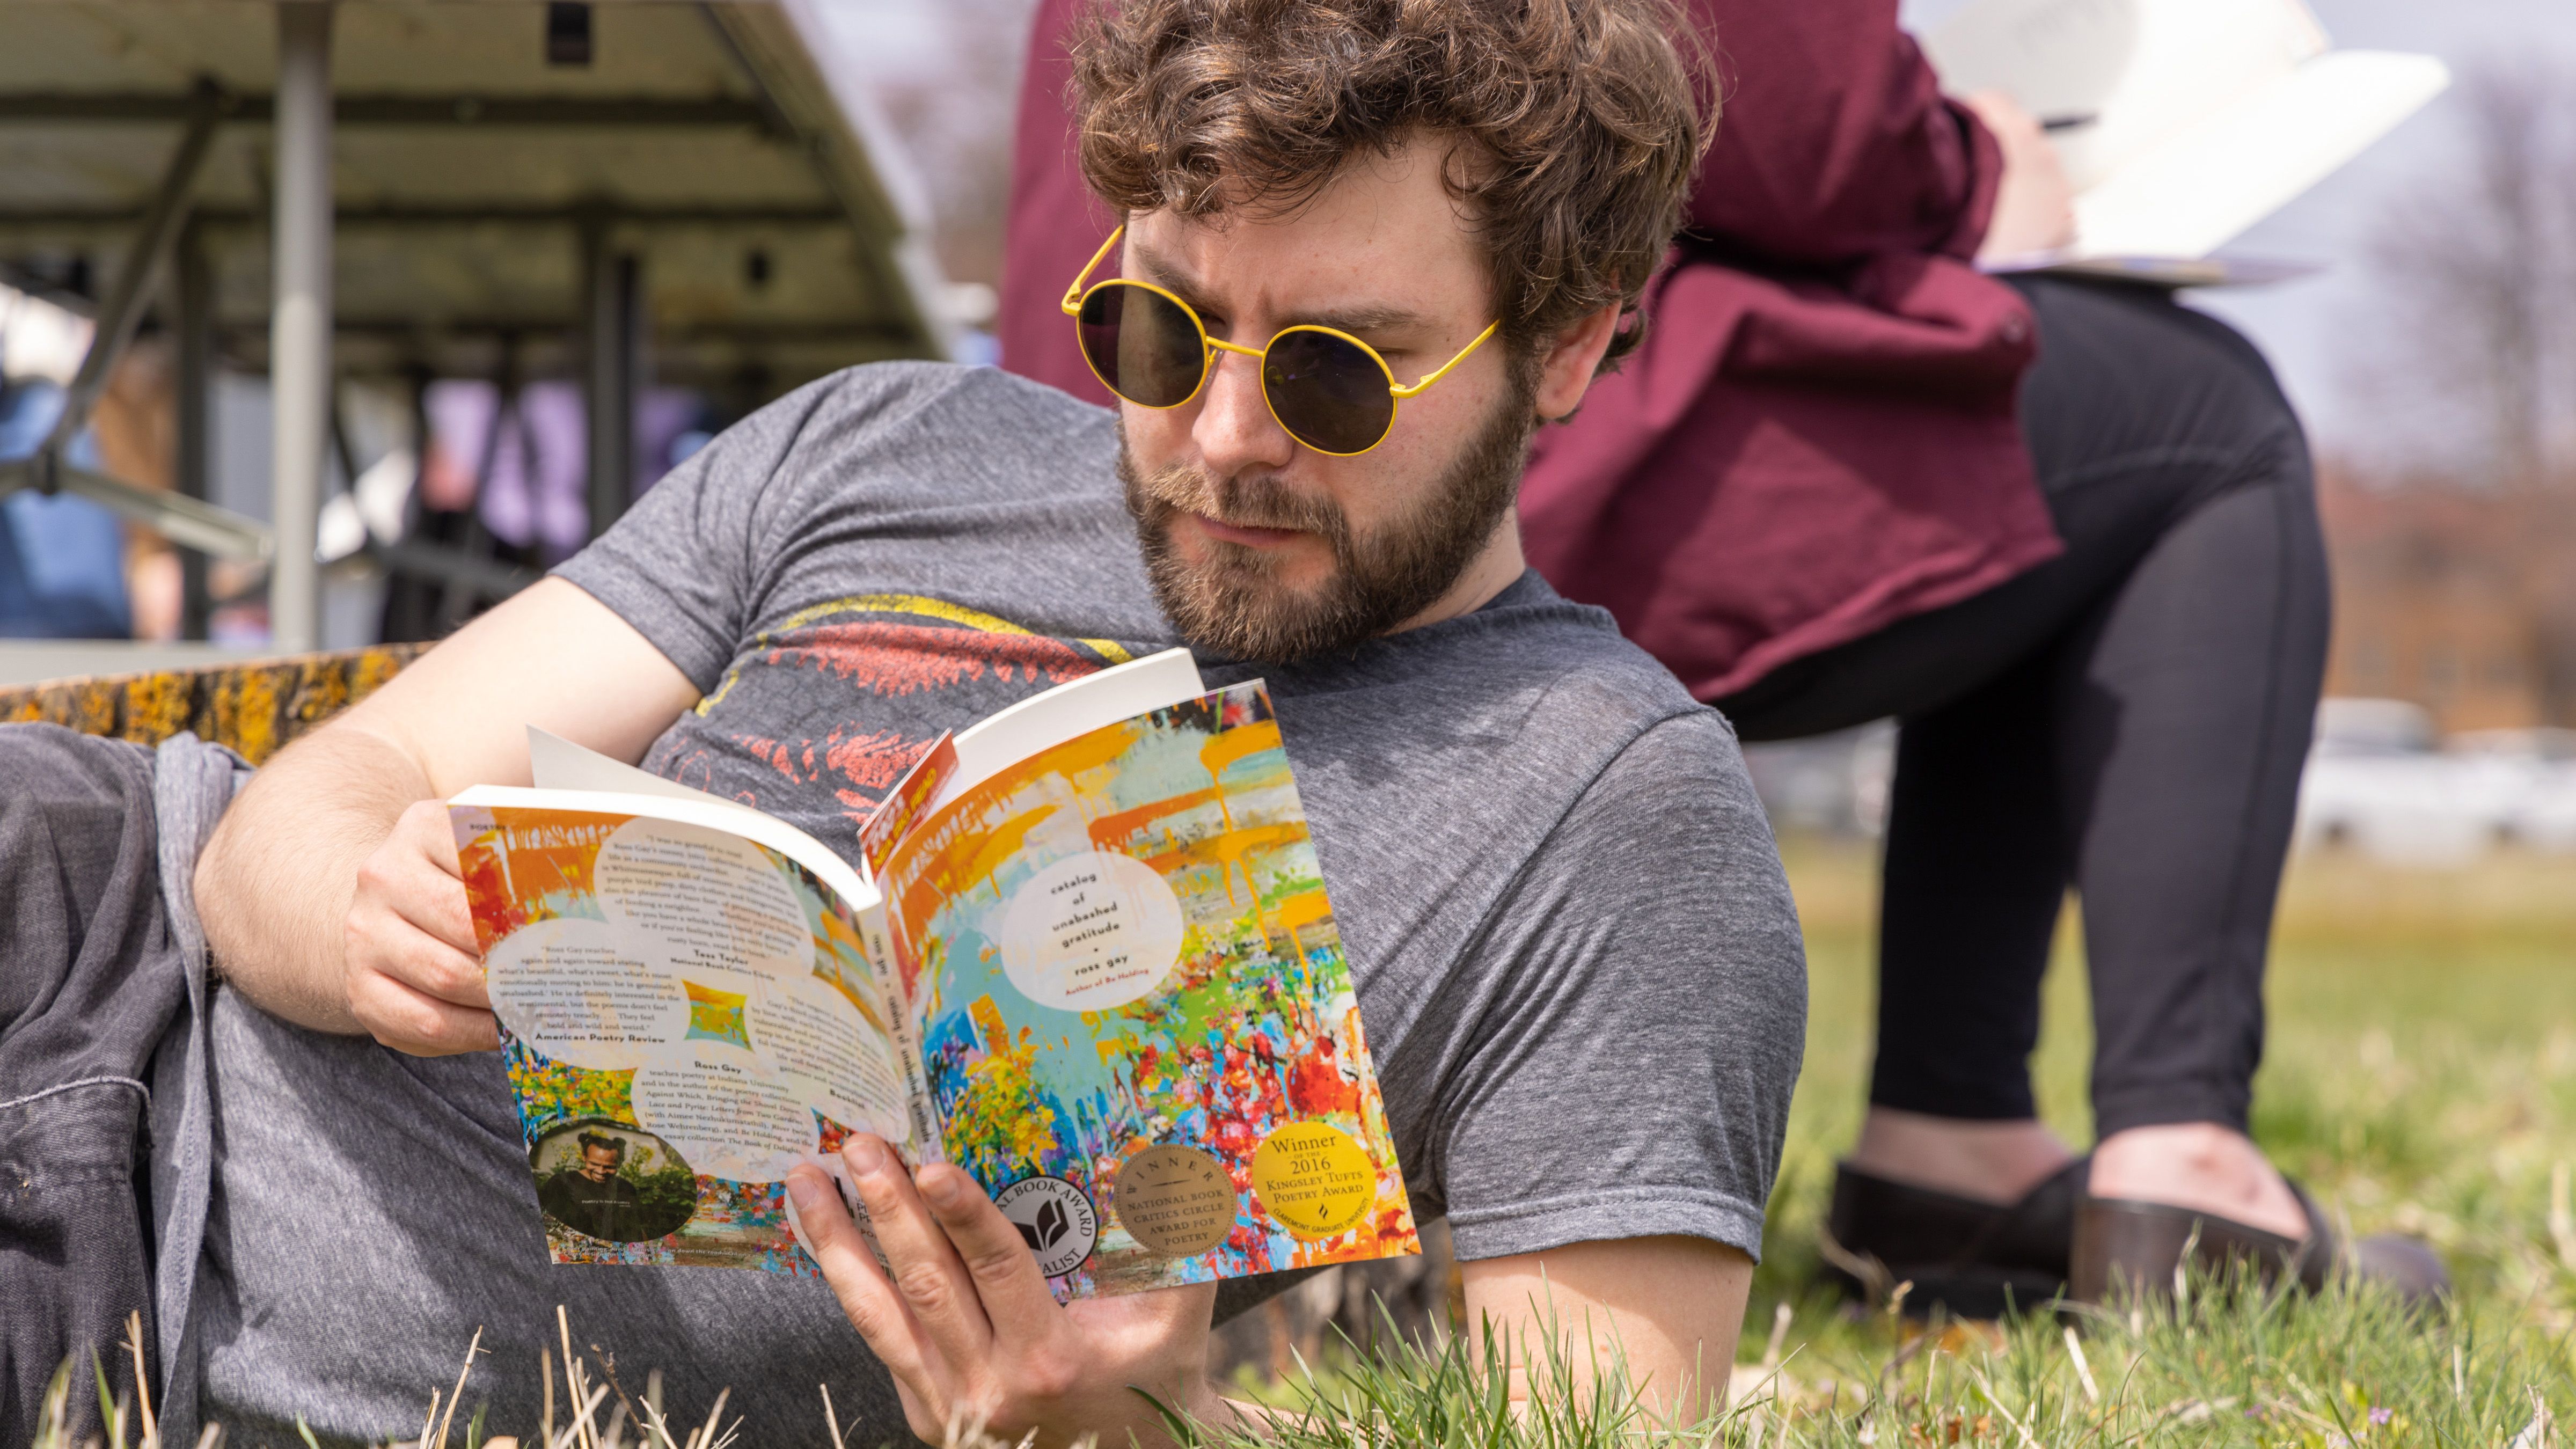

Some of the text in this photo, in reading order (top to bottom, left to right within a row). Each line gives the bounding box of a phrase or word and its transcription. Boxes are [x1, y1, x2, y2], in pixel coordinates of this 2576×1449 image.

[1050, 873, 1097, 894] catalog
[1073, 891, 1085, 905] of
[1052, 901, 1117, 931] unabashed
[1062, 921, 1120, 949] gratitude
[693, 948, 748, 965] Tess Taylor
[1075, 955, 1128, 976] ross gay
[1065, 983, 1093, 996] Author
[1094, 977, 1103, 987] of
[1118, 968, 1150, 979] Holding
[536, 1033, 665, 1043] American Poetry Review
[682, 1072, 706, 1080] poetry
[694, 1060, 741, 1074] Ross Gay
[1271, 1135, 1336, 1153] Winner
[1126, 1157, 1213, 1195] WINNER
[1290, 1156, 1331, 1175] 2016
[1128, 1189, 1224, 1211] NATIONAL BOOK
[1273, 1184, 1364, 1203] POETRY AWARD
[1014, 1180, 1093, 1237] BOOK AWARD
[1133, 1203, 1225, 1224] CRITICS CIRCLE
[1273, 1197, 1370, 1233] CLAREMONT GRADUATE UNIVERSITY
[1150, 1217, 1217, 1235] AWARD FOR
[1165, 1232, 1209, 1246] POETRY
[1042, 1247, 1081, 1274] ALIST
